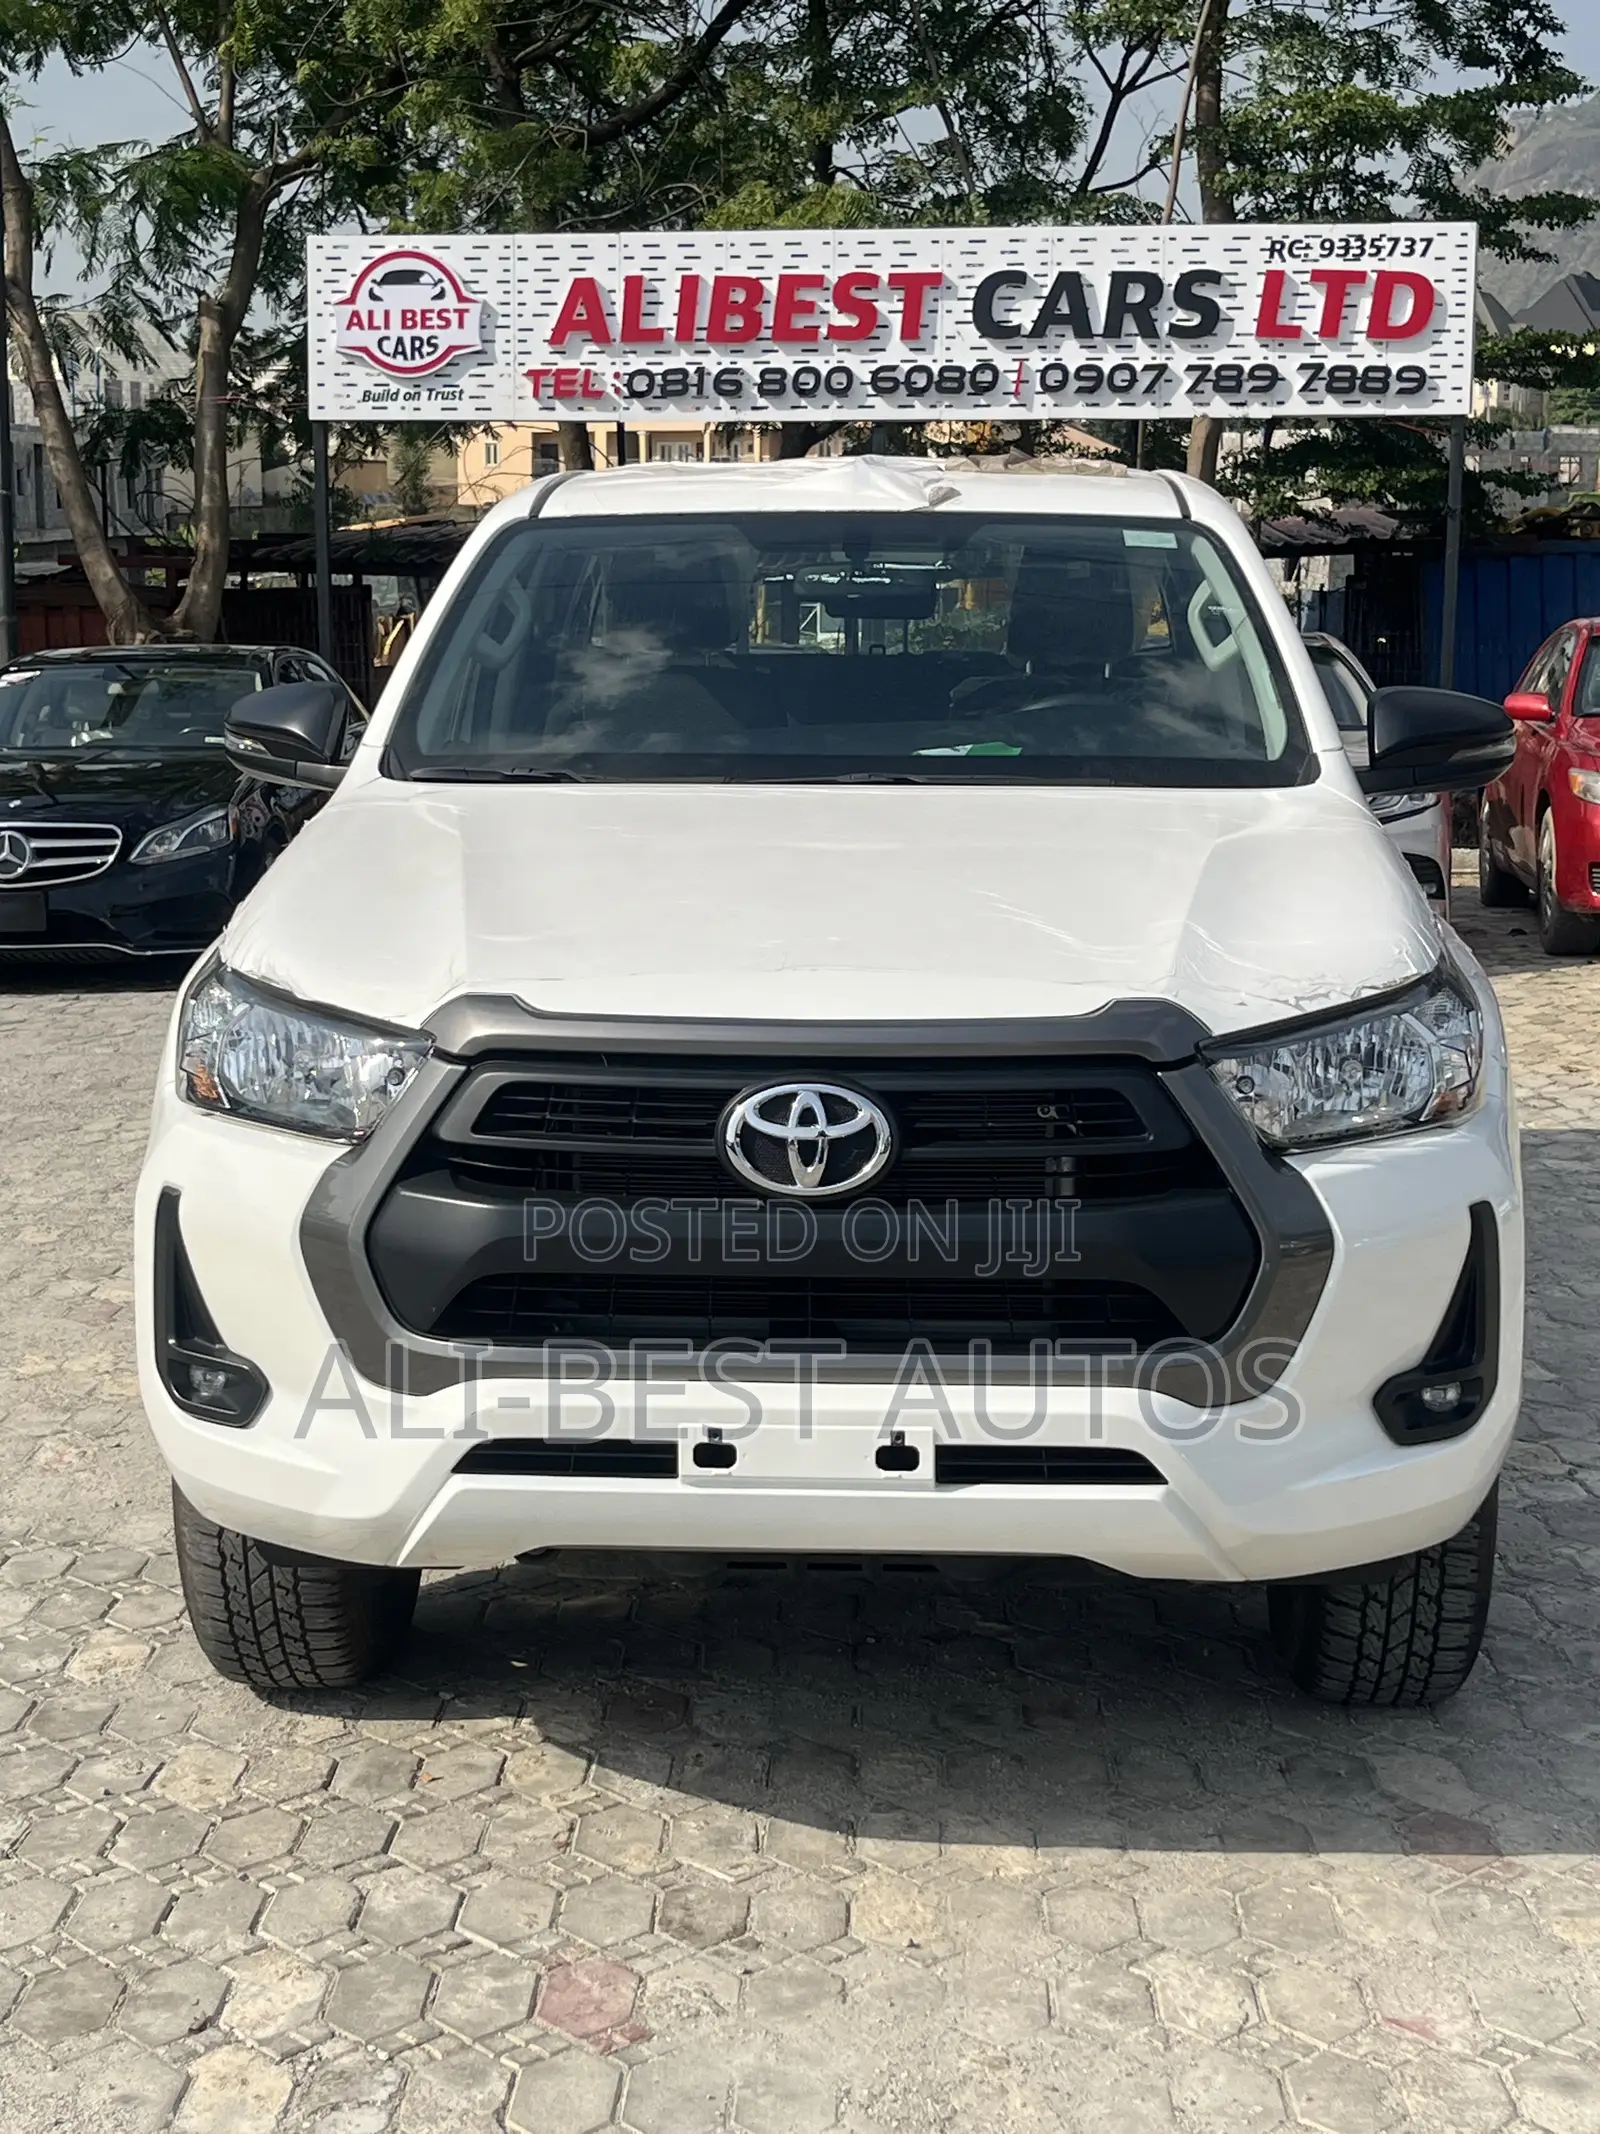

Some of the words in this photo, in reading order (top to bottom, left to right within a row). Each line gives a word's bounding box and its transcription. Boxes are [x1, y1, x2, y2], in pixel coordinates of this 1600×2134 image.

[1319, 237, 1434, 259] 9335737
[345, 309, 391, 331] ALI
[400, 308, 470, 330] BEST
[547, 271, 943, 347] ALIBEST
[971, 270, 1222, 340] CARS
[1255, 269, 1436, 341] LTD
[377, 334, 439, 361] CARS
[626, 366, 745, 399] 0816
[757, 366, 854, 397] 800
[871, 364, 999, 395] 6080
[1039, 362, 1169, 395] 0907
[1185, 363, 1279, 394] 789
[1297, 362, 1428, 395] 7889
[361, 388, 401, 403] Build
[403, 391, 421, 402] on
[427, 387, 465, 402] Trust
